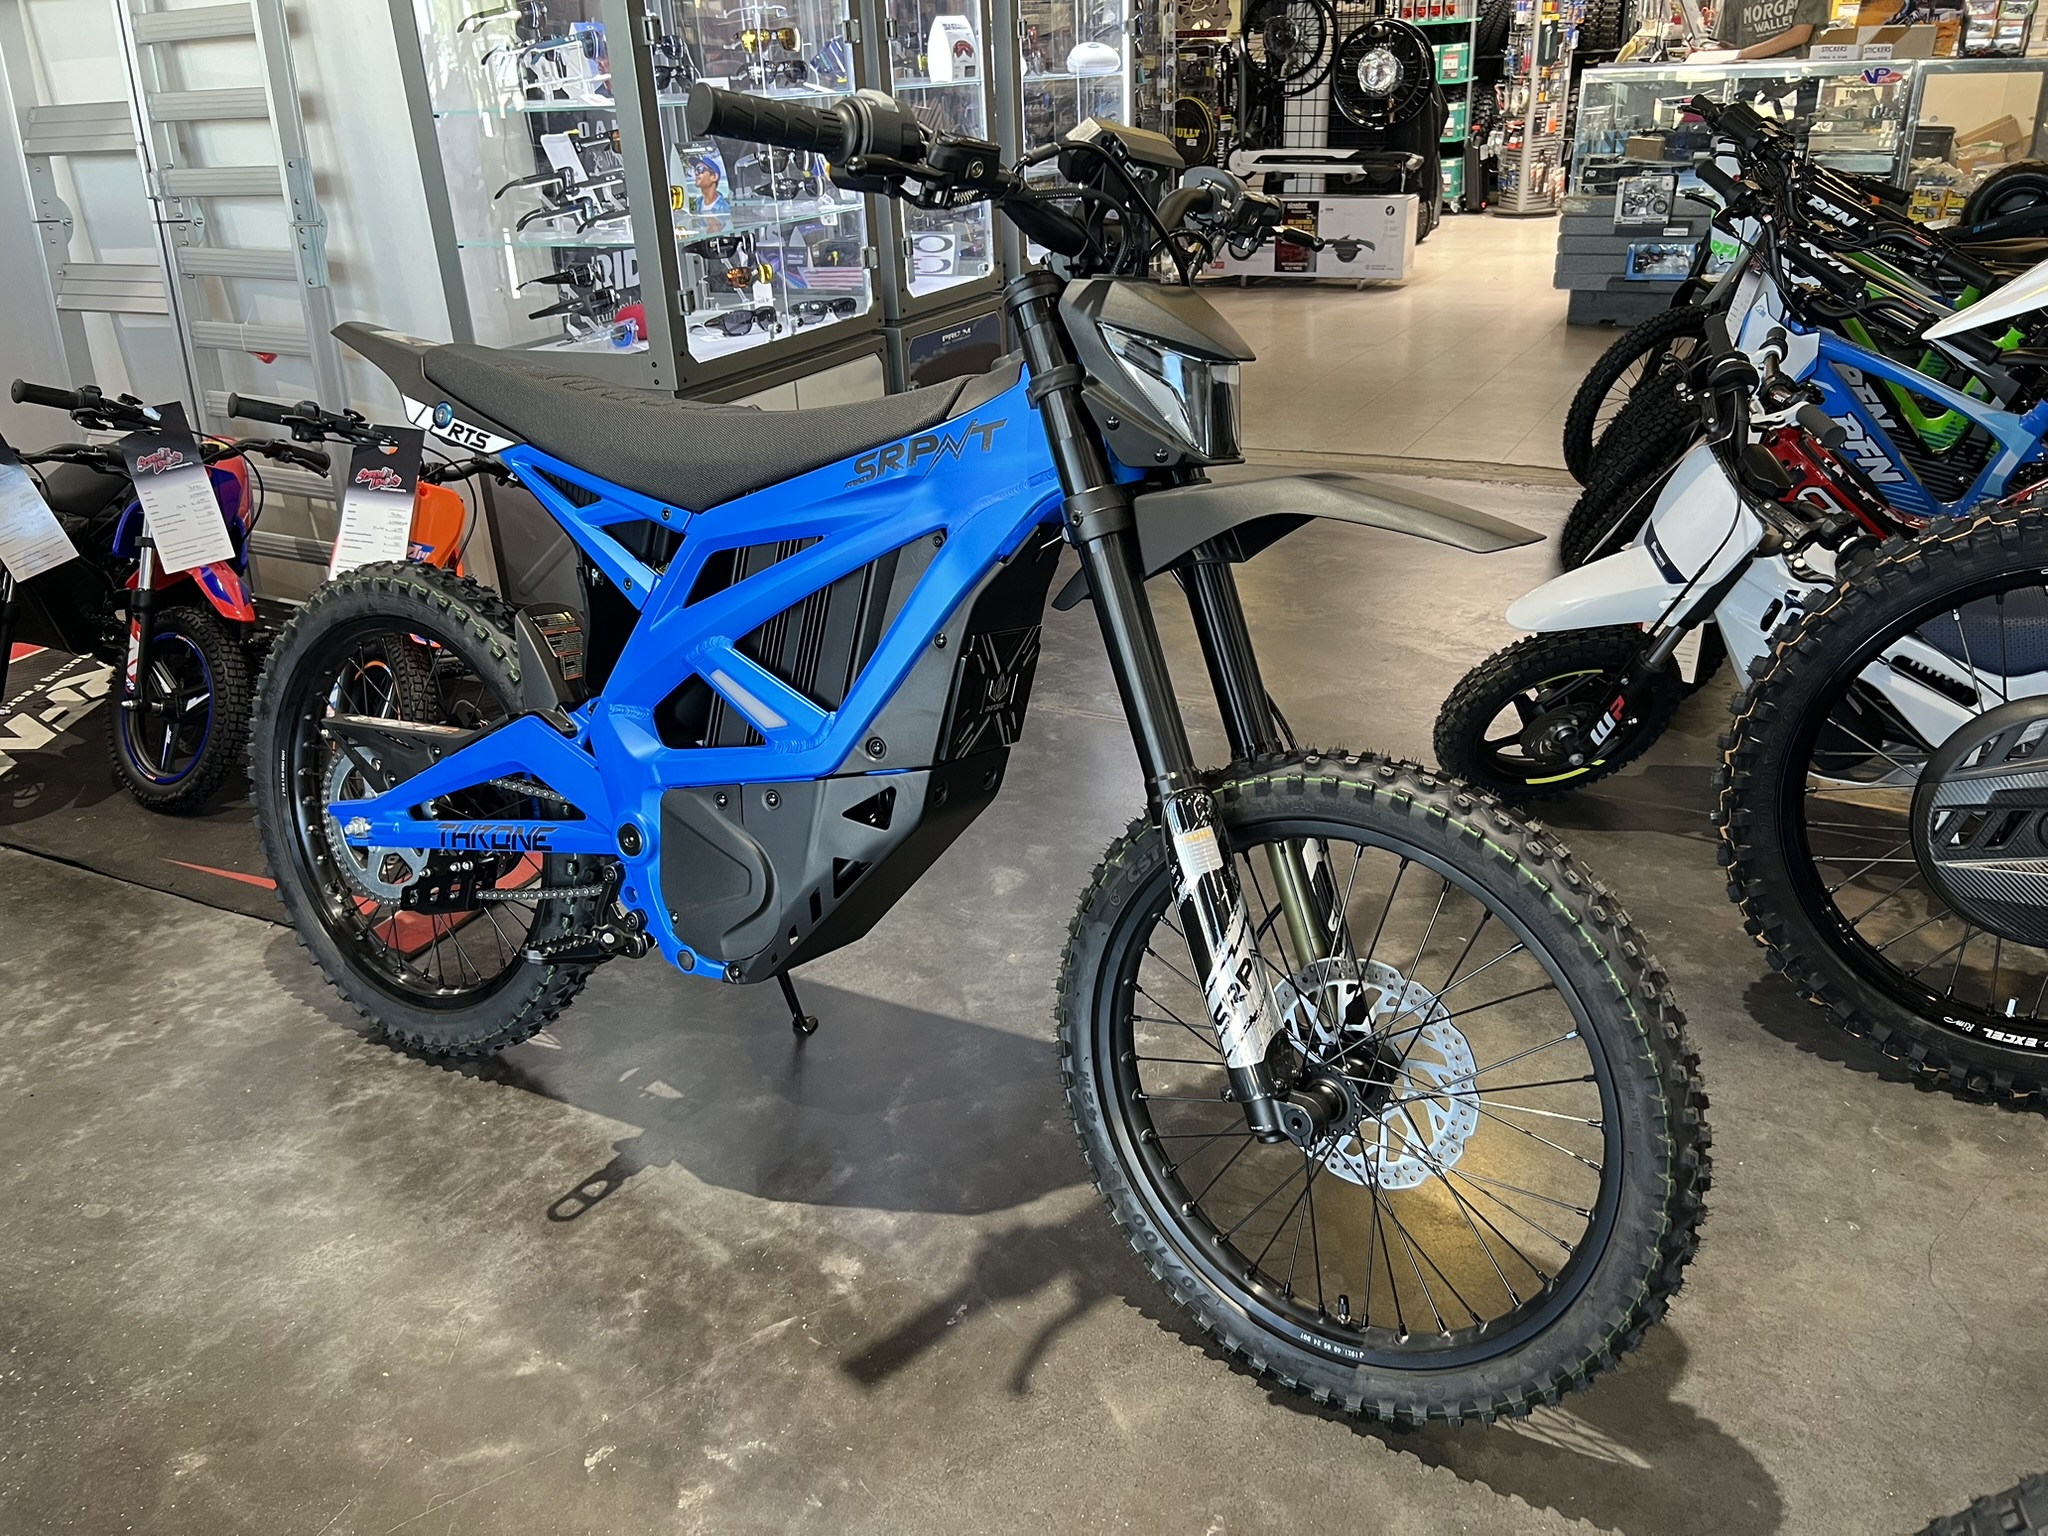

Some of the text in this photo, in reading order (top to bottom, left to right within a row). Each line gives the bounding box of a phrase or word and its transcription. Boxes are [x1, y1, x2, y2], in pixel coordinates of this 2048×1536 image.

[1821, 45, 1848, 53] STICKERS
[1864, 46, 1891, 54] STICKERS
[1863, 67, 1891, 84] VP
[1175, 128, 1201, 138] ULLY
[437, 422, 492, 450] RTS
[437, 822, 559, 852] THRONE
[1982, 1027, 2039, 1048] EXCEL
